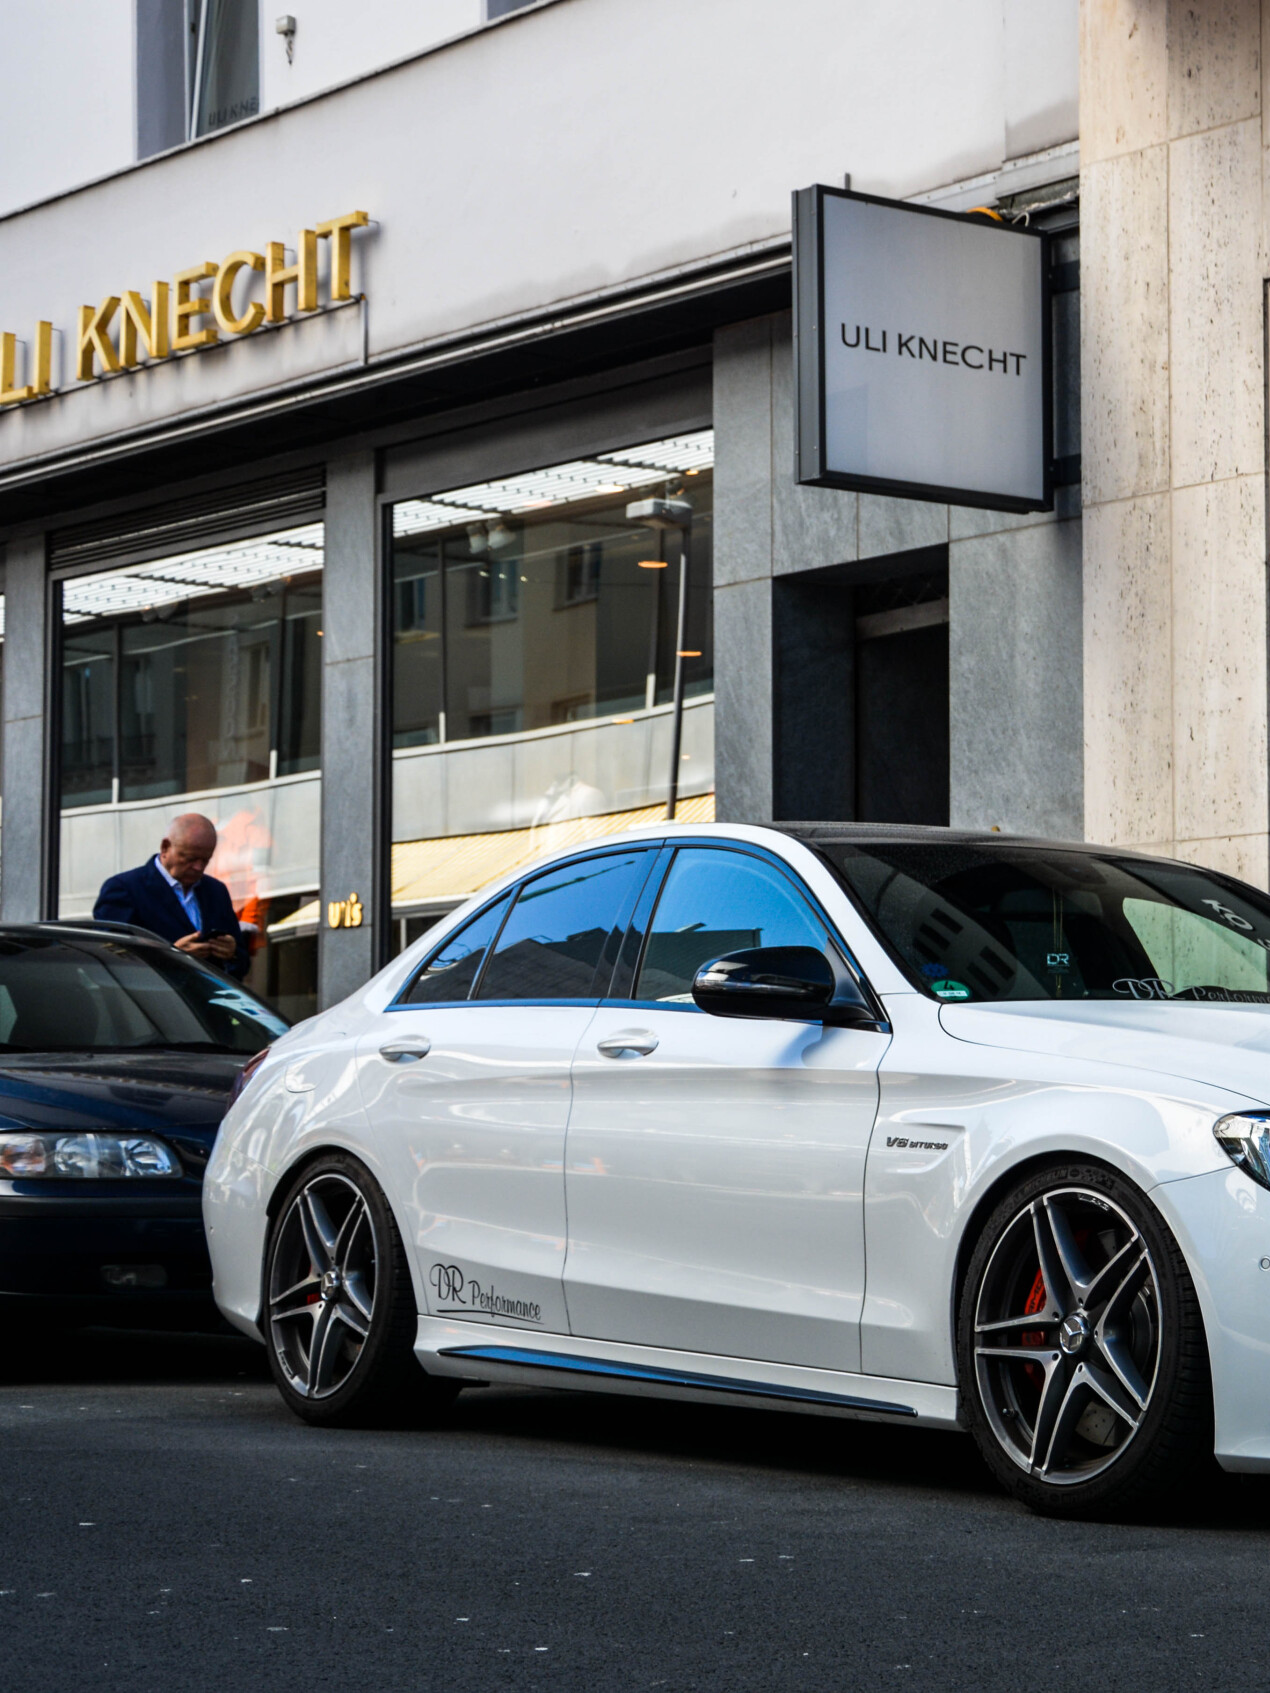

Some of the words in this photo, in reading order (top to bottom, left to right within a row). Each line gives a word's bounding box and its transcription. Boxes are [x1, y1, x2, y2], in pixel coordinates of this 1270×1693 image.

[76, 210, 369, 381] KNECHT
[840, 322, 888, 354] ULI
[897, 332, 1028, 377] KNECHT
[1046, 953, 1070, 966] DR
[429, 1263, 467, 1305] DR
[468, 1280, 541, 1320] Performance
